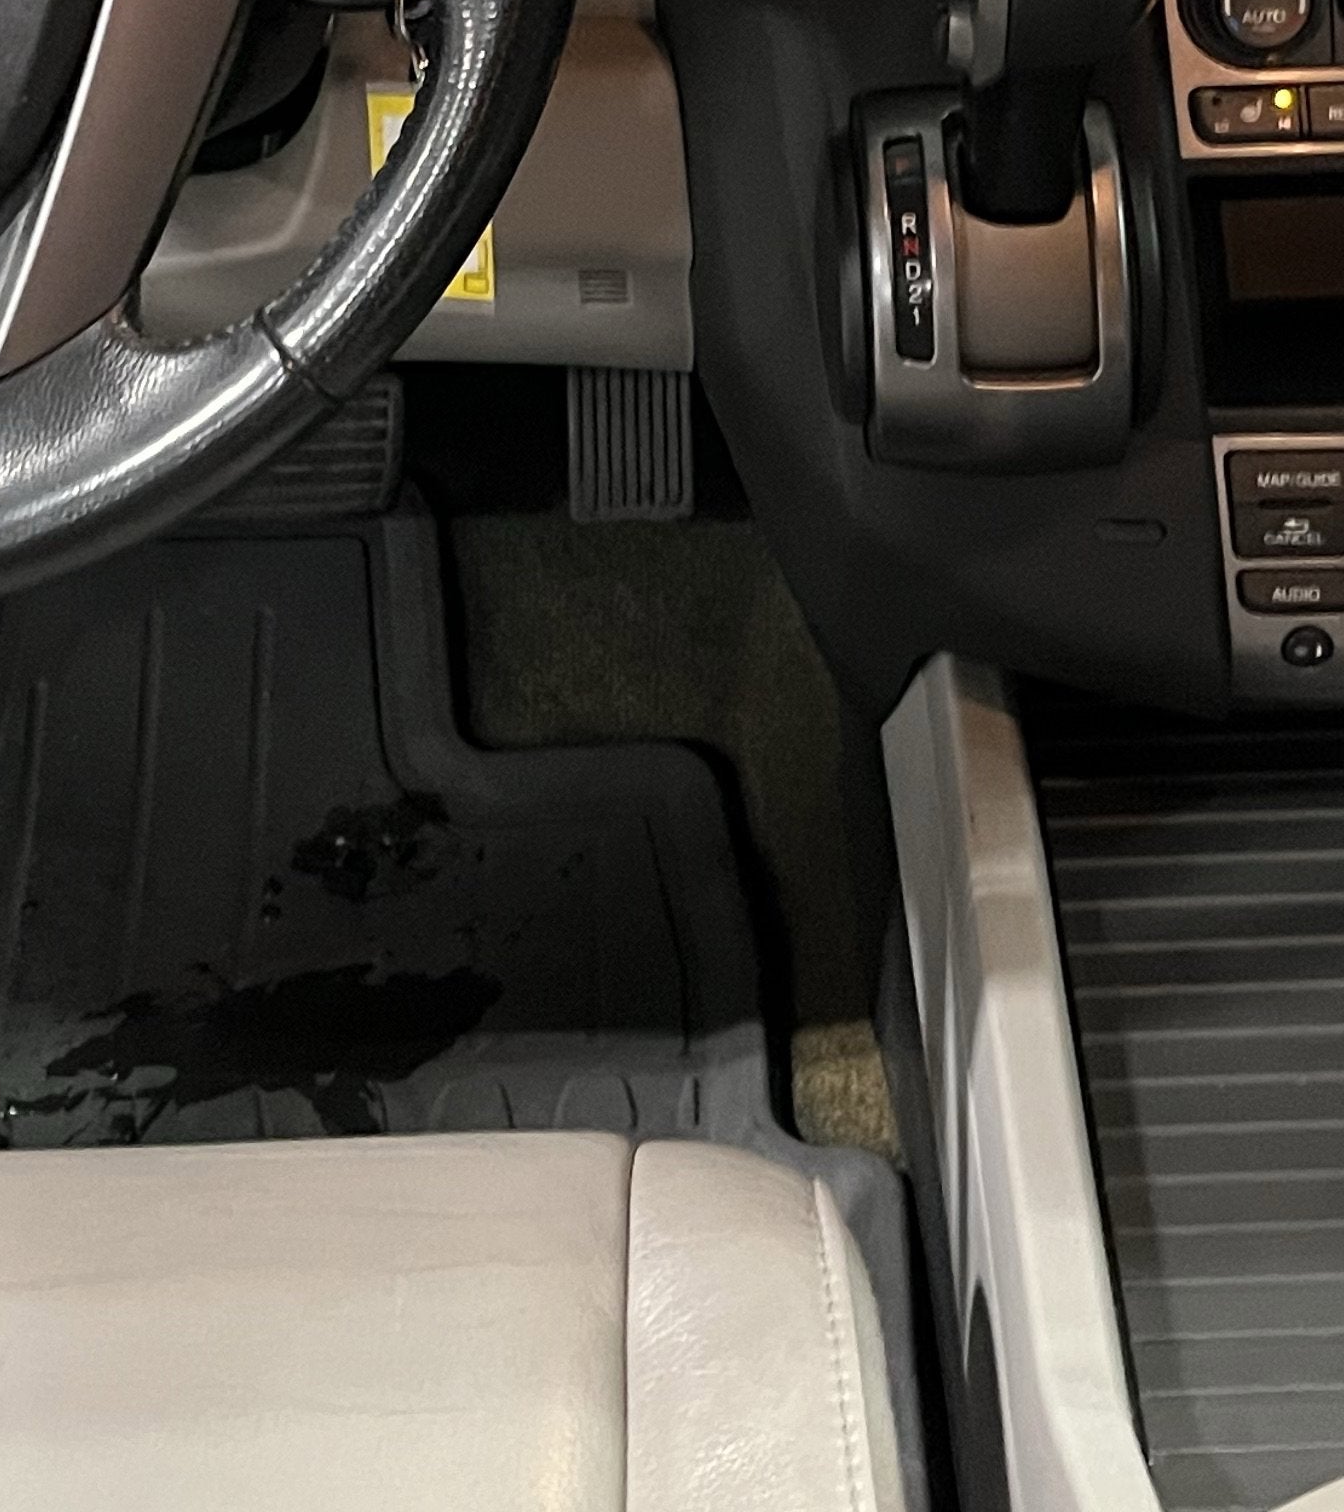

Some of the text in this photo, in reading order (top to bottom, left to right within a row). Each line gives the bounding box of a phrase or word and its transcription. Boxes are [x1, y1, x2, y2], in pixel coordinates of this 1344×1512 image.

[1242, 8, 1286, 25] AUTO
[901, 212, 917, 235] R
[906, 260, 921, 281] D
[908, 284, 923, 305] 2
[912, 306, 920, 326] 1
[1257, 471, 1341, 487] MAP/GUIDE
[1272, 586, 1320, 604] AUDIO
